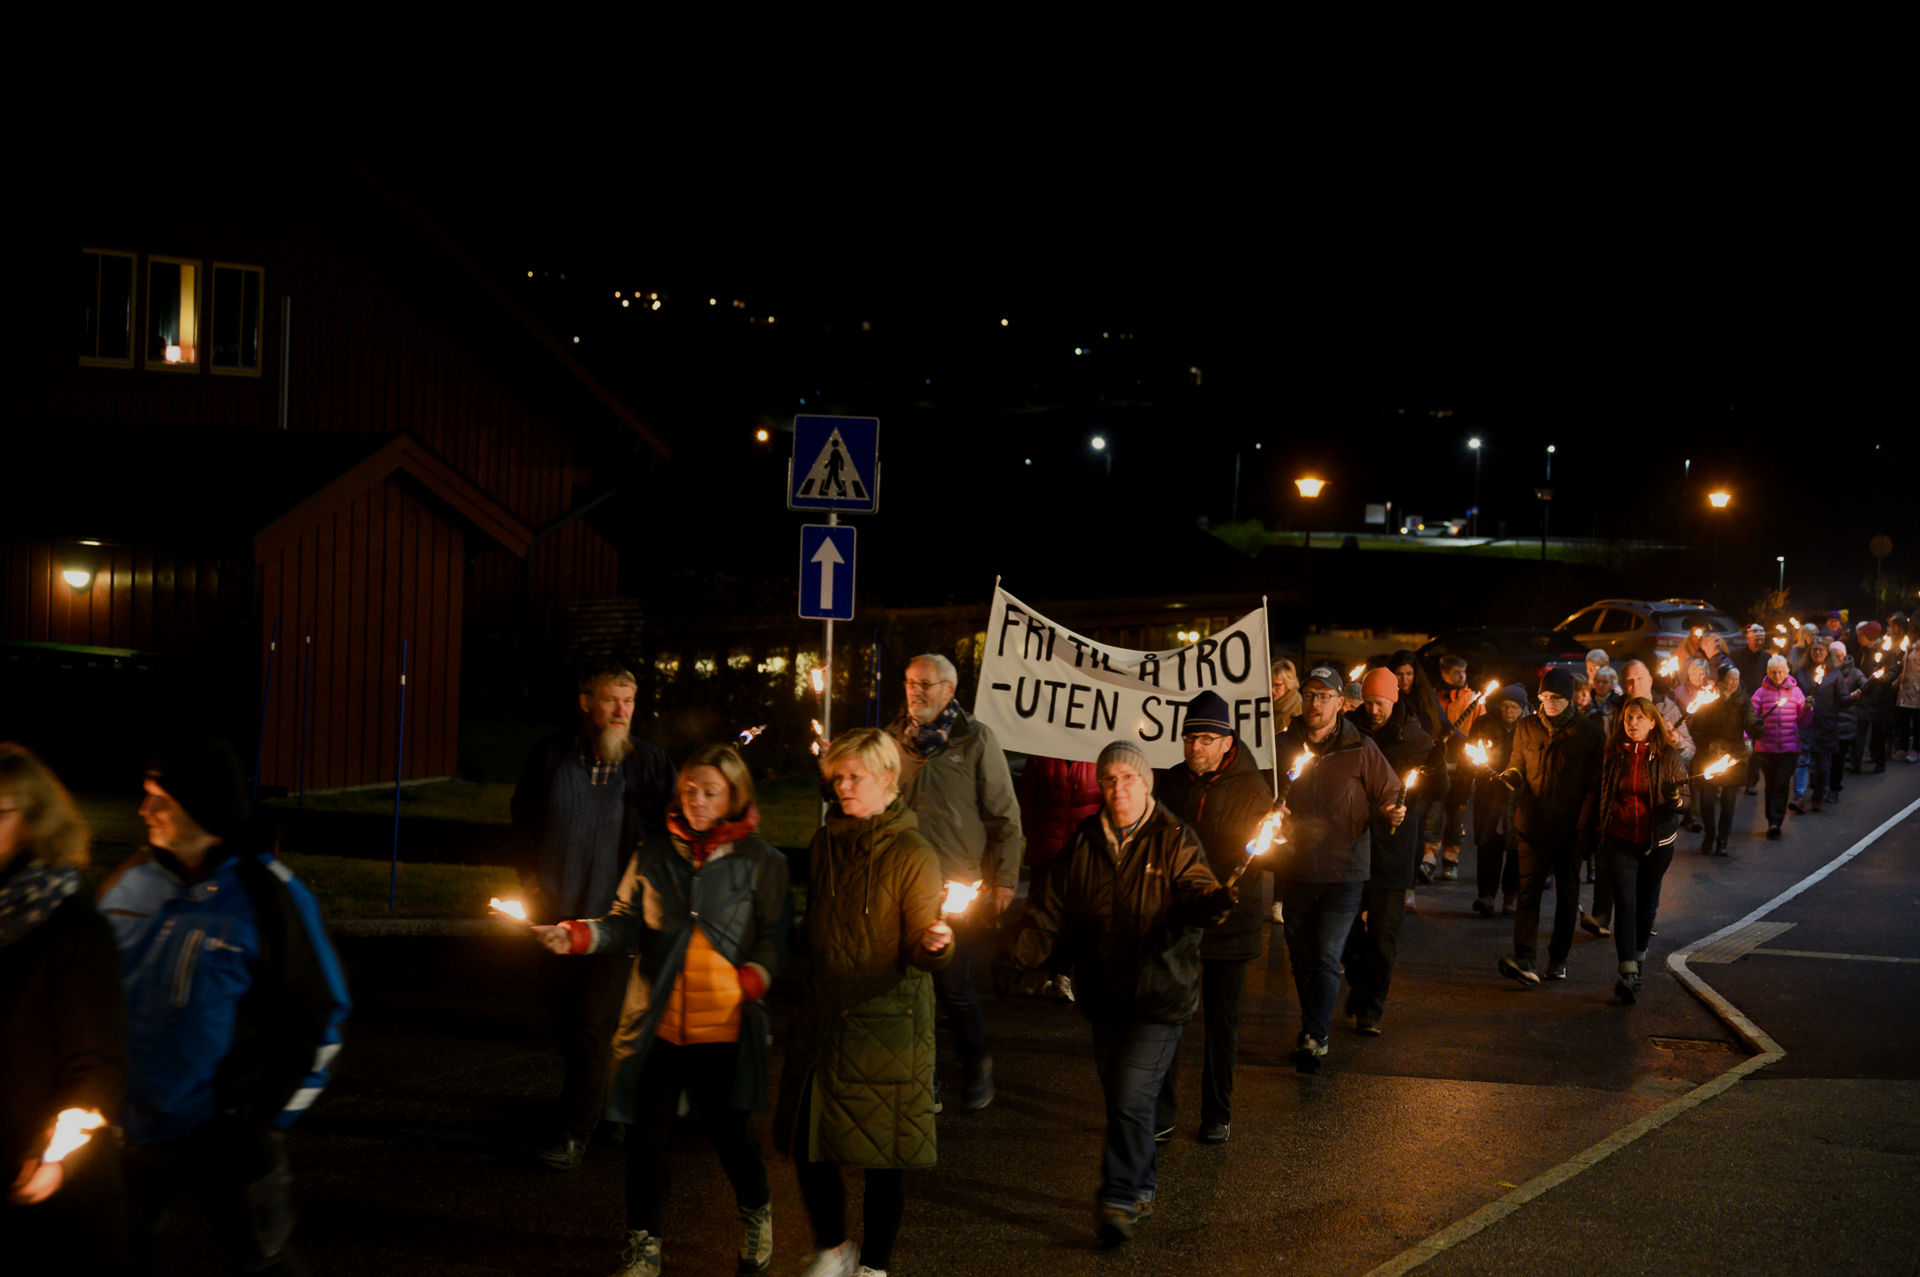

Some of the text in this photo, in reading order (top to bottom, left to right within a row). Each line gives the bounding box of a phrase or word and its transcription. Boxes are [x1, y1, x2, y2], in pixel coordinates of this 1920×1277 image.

[998, 604, 1251, 691] FRI TIL Å TRO
[991, 676, 1271, 748] -UTEN STFF
